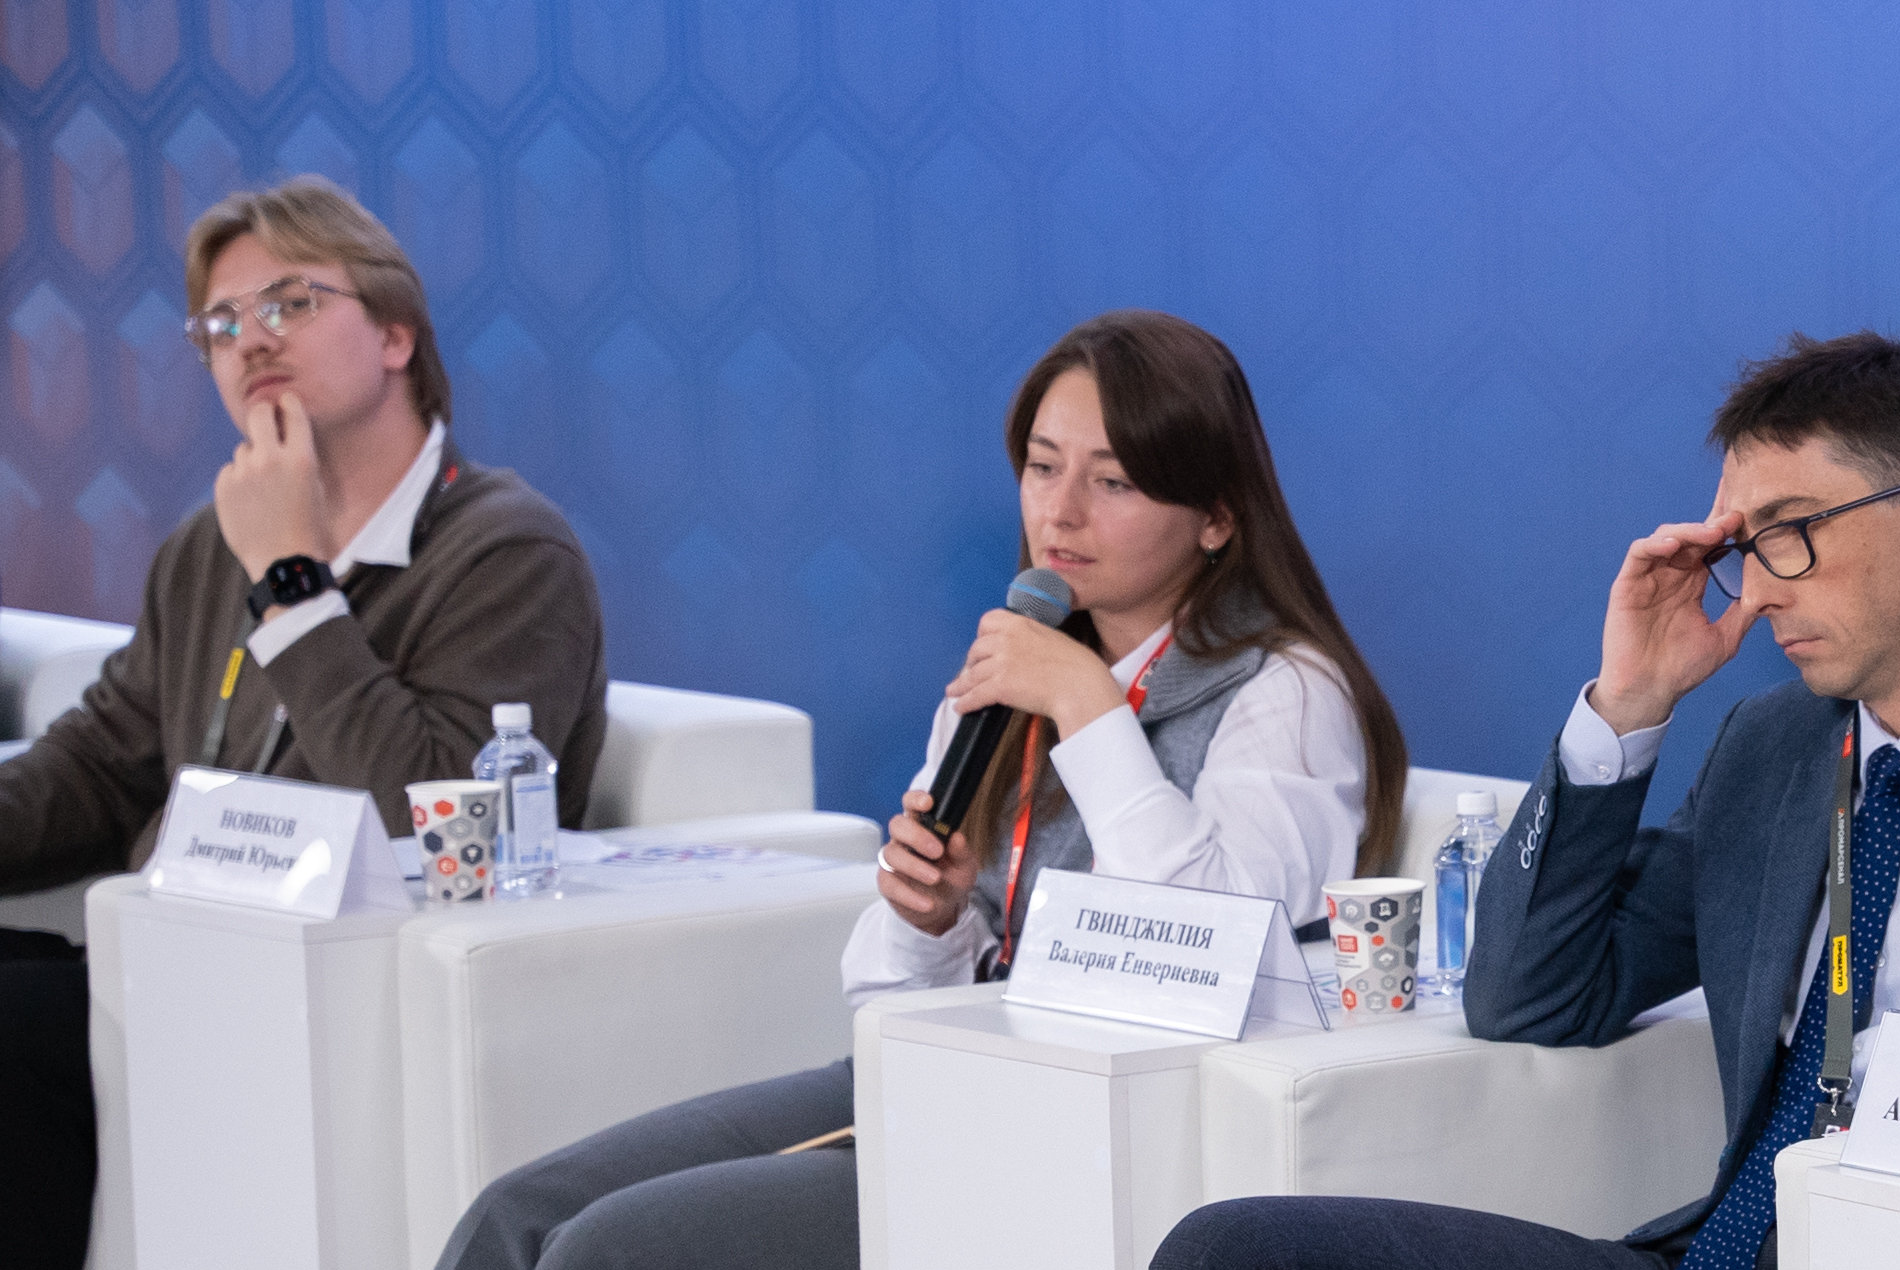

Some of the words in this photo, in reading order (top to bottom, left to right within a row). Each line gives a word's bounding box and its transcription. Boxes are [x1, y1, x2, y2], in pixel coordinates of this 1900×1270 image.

[220, 809, 297, 838] НОВИКОВ
[185, 836, 247, 866] Дмитрий
[249, 844, 297, 873] Юрьев
[1075, 908, 1214, 949] ГВИНДЖИЛИЯ
[1048, 940, 1117, 973] Валерия
[1120, 952, 1220, 987] Енвериевна
